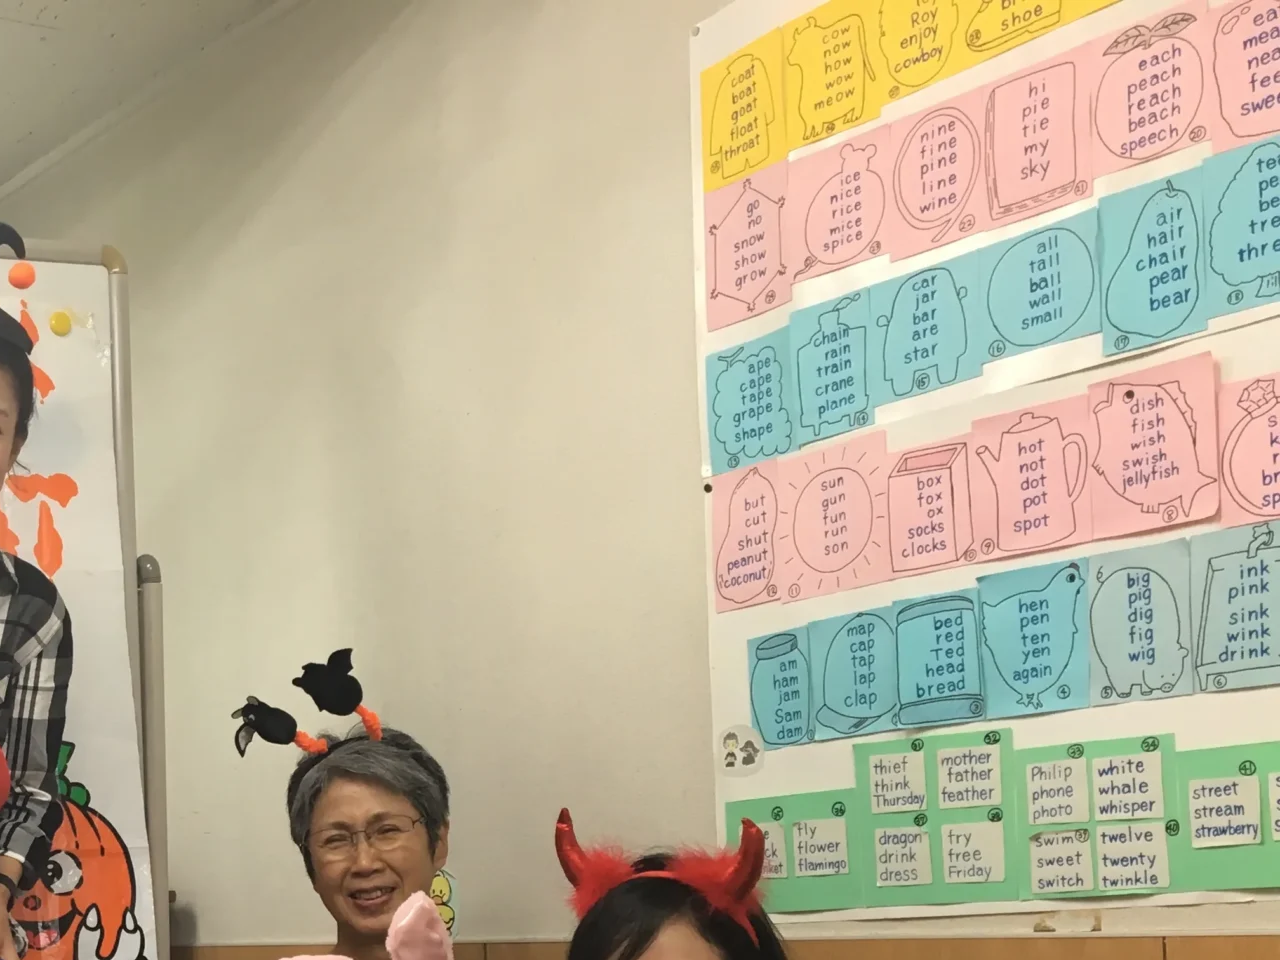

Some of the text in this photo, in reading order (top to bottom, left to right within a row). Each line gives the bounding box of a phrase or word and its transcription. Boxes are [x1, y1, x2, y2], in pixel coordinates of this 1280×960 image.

[911, 8, 938, 29] Roy
[1001, 5, 1043, 32] shoe
[822, 26, 851, 44] cow
[900, 24, 938, 49] enjoy
[823, 42, 852, 59] now
[1138, 44, 1181, 71] each
[824, 57, 853, 75] how
[894, 46, 943, 74] cowboy
[730, 64, 755, 87] coat
[825, 72, 854, 90] wow
[1128, 64, 1181, 101] peach
[732, 82, 757, 104] boat
[1029, 78, 1046, 98] hi
[814, 87, 855, 111] meow
[1128, 84, 1181, 116] reach
[731, 100, 757, 124] goat
[1022, 98, 1049, 122] pie
[1128, 103, 1181, 133] beach
[920, 121, 956, 143] nine
[1022, 118, 1049, 138] tie
[725, 134, 760, 161] throat
[1024, 140, 1049, 157] my
[1121, 124, 1179, 157] speech
[920, 152, 957, 179] pine
[1021, 159, 1050, 181] sky
[841, 171, 861, 186] ice
[922, 173, 957, 195] line
[830, 185, 862, 205] nice
[919, 193, 957, 214] wine
[747, 200, 760, 218] go
[832, 201, 862, 219] rice
[1156, 207, 1182, 226] air
[748, 215, 762, 229] no
[734, 232, 765, 253] snow
[823, 230, 863, 253] spice
[1037, 235, 1058, 254] all
[1147, 225, 1184, 248] hair
[735, 251, 766, 270] show
[1029, 253, 1060, 273] tall
[1136, 245, 1186, 272] chair
[735, 267, 767, 290] grow
[912, 275, 937, 292] car
[1030, 272, 1061, 293] ball
[1150, 265, 1188, 295] pear
[915, 290, 937, 311] jar
[1029, 288, 1062, 309] wall
[1150, 288, 1191, 311] bear
[913, 308, 937, 325] bar
[1022, 307, 1063, 330] small
[814, 327, 849, 348] chain
[912, 324, 939, 342] are
[825, 343, 851, 360] rain
[904, 343, 938, 364] star
[748, 357, 771, 376] ape
[817, 358, 852, 377] train
[740, 373, 772, 392] cape
[816, 376, 854, 396] crane
[742, 388, 773, 405] tape
[1130, 392, 1164, 414] dish
[733, 403, 773, 427] grape
[818, 393, 855, 419] plane
[1131, 413, 1165, 433] fish
[735, 422, 773, 443] shape
[1018, 439, 1044, 456] hot
[1020, 457, 1046, 473] not
[1122, 448, 1167, 470] swish
[821, 477, 844, 491] sun
[917, 475, 942, 491] box
[1021, 474, 1047, 491] dot
[1122, 461, 1179, 494] jellyfish
[744, 494, 766, 511] but
[822, 493, 846, 511] gun
[917, 493, 943, 508] fox
[1023, 492, 1048, 514] pot
[745, 511, 767, 528] cut
[823, 511, 846, 525] fun
[927, 507, 943, 519] ox
[825, 525, 847, 538] run
[908, 521, 945, 539] socks
[1013, 514, 1050, 535] spot
[738, 530, 768, 551] shut
[825, 541, 848, 556] son
[902, 538, 947, 558] clocks
[728, 550, 768, 574] peanut
[1240, 560, 1270, 579] ink
[1127, 572, 1150, 588] big
[1128, 588, 1151, 608] pig
[1228, 578, 1270, 604] pink
[1019, 598, 1049, 613] hen
[1228, 603, 1269, 625] sink
[934, 611, 963, 631] bed
[1020, 613, 1049, 632] pen
[1128, 608, 1153, 624] dig
[847, 623, 875, 637] map
[936, 627, 964, 644] red
[1129, 626, 1153, 645] fig
[1227, 623, 1271, 642] wink
[850, 639, 875, 653] cap
[1021, 633, 1050, 646] ten
[930, 642, 965, 661] Ted
[1022, 646, 1050, 664] yen
[1128, 647, 1155, 665] wig
[1219, 642, 1270, 662] drink
[780, 660, 798, 672] am
[851, 655, 875, 670] tap
[926, 660, 965, 678] head
[773, 675, 799, 690] ham
[853, 671, 876, 688] lap
[1013, 664, 1052, 684] again
[917, 676, 965, 698] bread
[778, 689, 800, 706] jam
[844, 691, 877, 710] clap
[775, 709, 802, 724] Sam
[777, 726, 803, 740] dam
[873, 756, 908, 775] thief
[941, 751, 992, 766] mother
[947, 767, 994, 783] father
[1032, 765, 1072, 782] Philip
[1098, 760, 1145, 777] white
[874, 776, 910, 793] think
[1099, 779, 1149, 795] whale
[1193, 782, 1239, 800] street
[873, 794, 925, 809] Thursday
[942, 787, 994, 803] feather
[1033, 786, 1073, 804] phone
[1033, 804, 1073, 823] photo
[1099, 800, 1155, 816] whisper
[1194, 803, 1244, 819] stream
[797, 823, 817, 837] fly
[948, 830, 971, 846] fry
[1101, 826, 1153, 844] twelve
[1195, 821, 1258, 840] strawberry
[798, 841, 840, 854] flower
[879, 831, 921, 849] dragon
[1036, 834, 1073, 848] swim
[879, 849, 916, 864] drink
[948, 849, 982, 862] free
[1037, 852, 1083, 868] sweet
[1102, 852, 1156, 869] twenty
[798, 859, 846, 873] flamingo
[880, 868, 918, 882] dress
[948, 866, 992, 881] Friday
[1038, 873, 1084, 890] switch
[1102, 870, 1159, 887] twinkle
